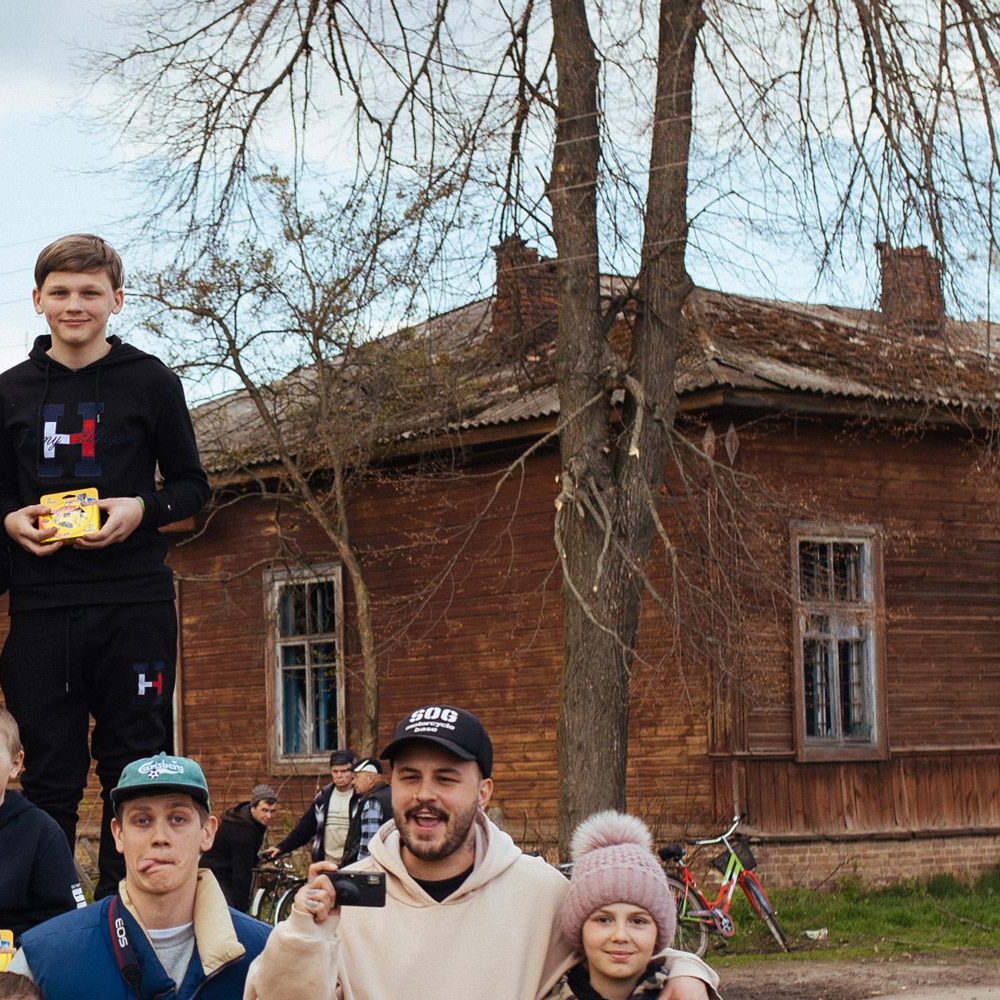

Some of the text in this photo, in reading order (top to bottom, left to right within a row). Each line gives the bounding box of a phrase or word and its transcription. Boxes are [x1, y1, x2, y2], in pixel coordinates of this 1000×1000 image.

[409, 707, 458, 723] SOG
[405, 721, 455, 731] motorcycle
[138, 760, 184, 774] Carlsberg
[115, 918, 128, 948] EOS
